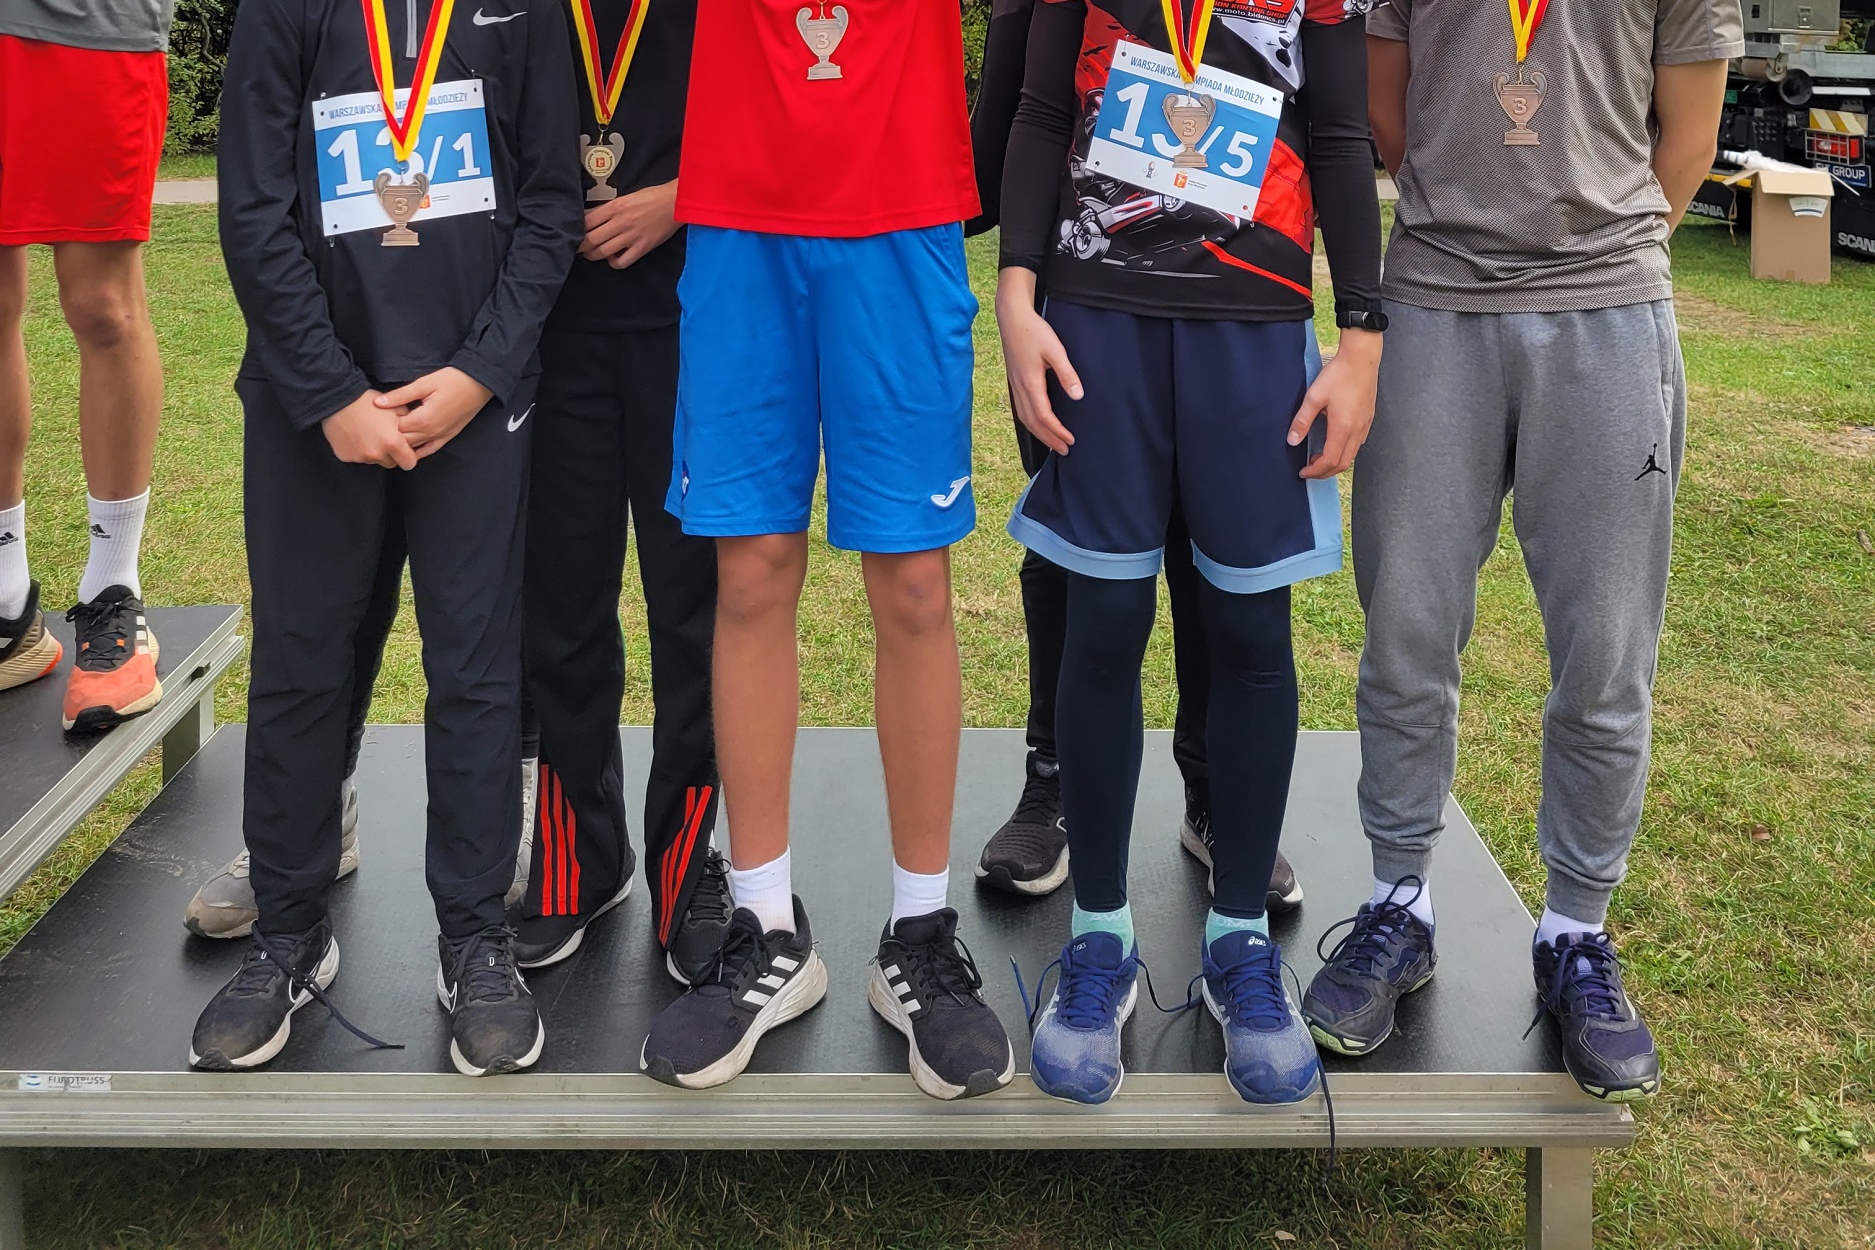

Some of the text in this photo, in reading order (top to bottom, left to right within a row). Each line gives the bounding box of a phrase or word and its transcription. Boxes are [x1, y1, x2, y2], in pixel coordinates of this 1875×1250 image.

[816, 31, 830, 49] 3
[1130, 55, 1181, 80] WARSZAWSKA
[1223, 83, 1265, 106] MŁODZIEŻY
[328, 105, 383, 120] WARSZAWSKA
[1513, 96, 1527, 116] 3
[1182, 119, 1196, 137] 3
[327, 124, 482, 197] 13/1
[1832, 165, 1866, 180] GROUP
[393, 197, 409, 215] 3
[1837, 231, 1875, 253] SCAN
